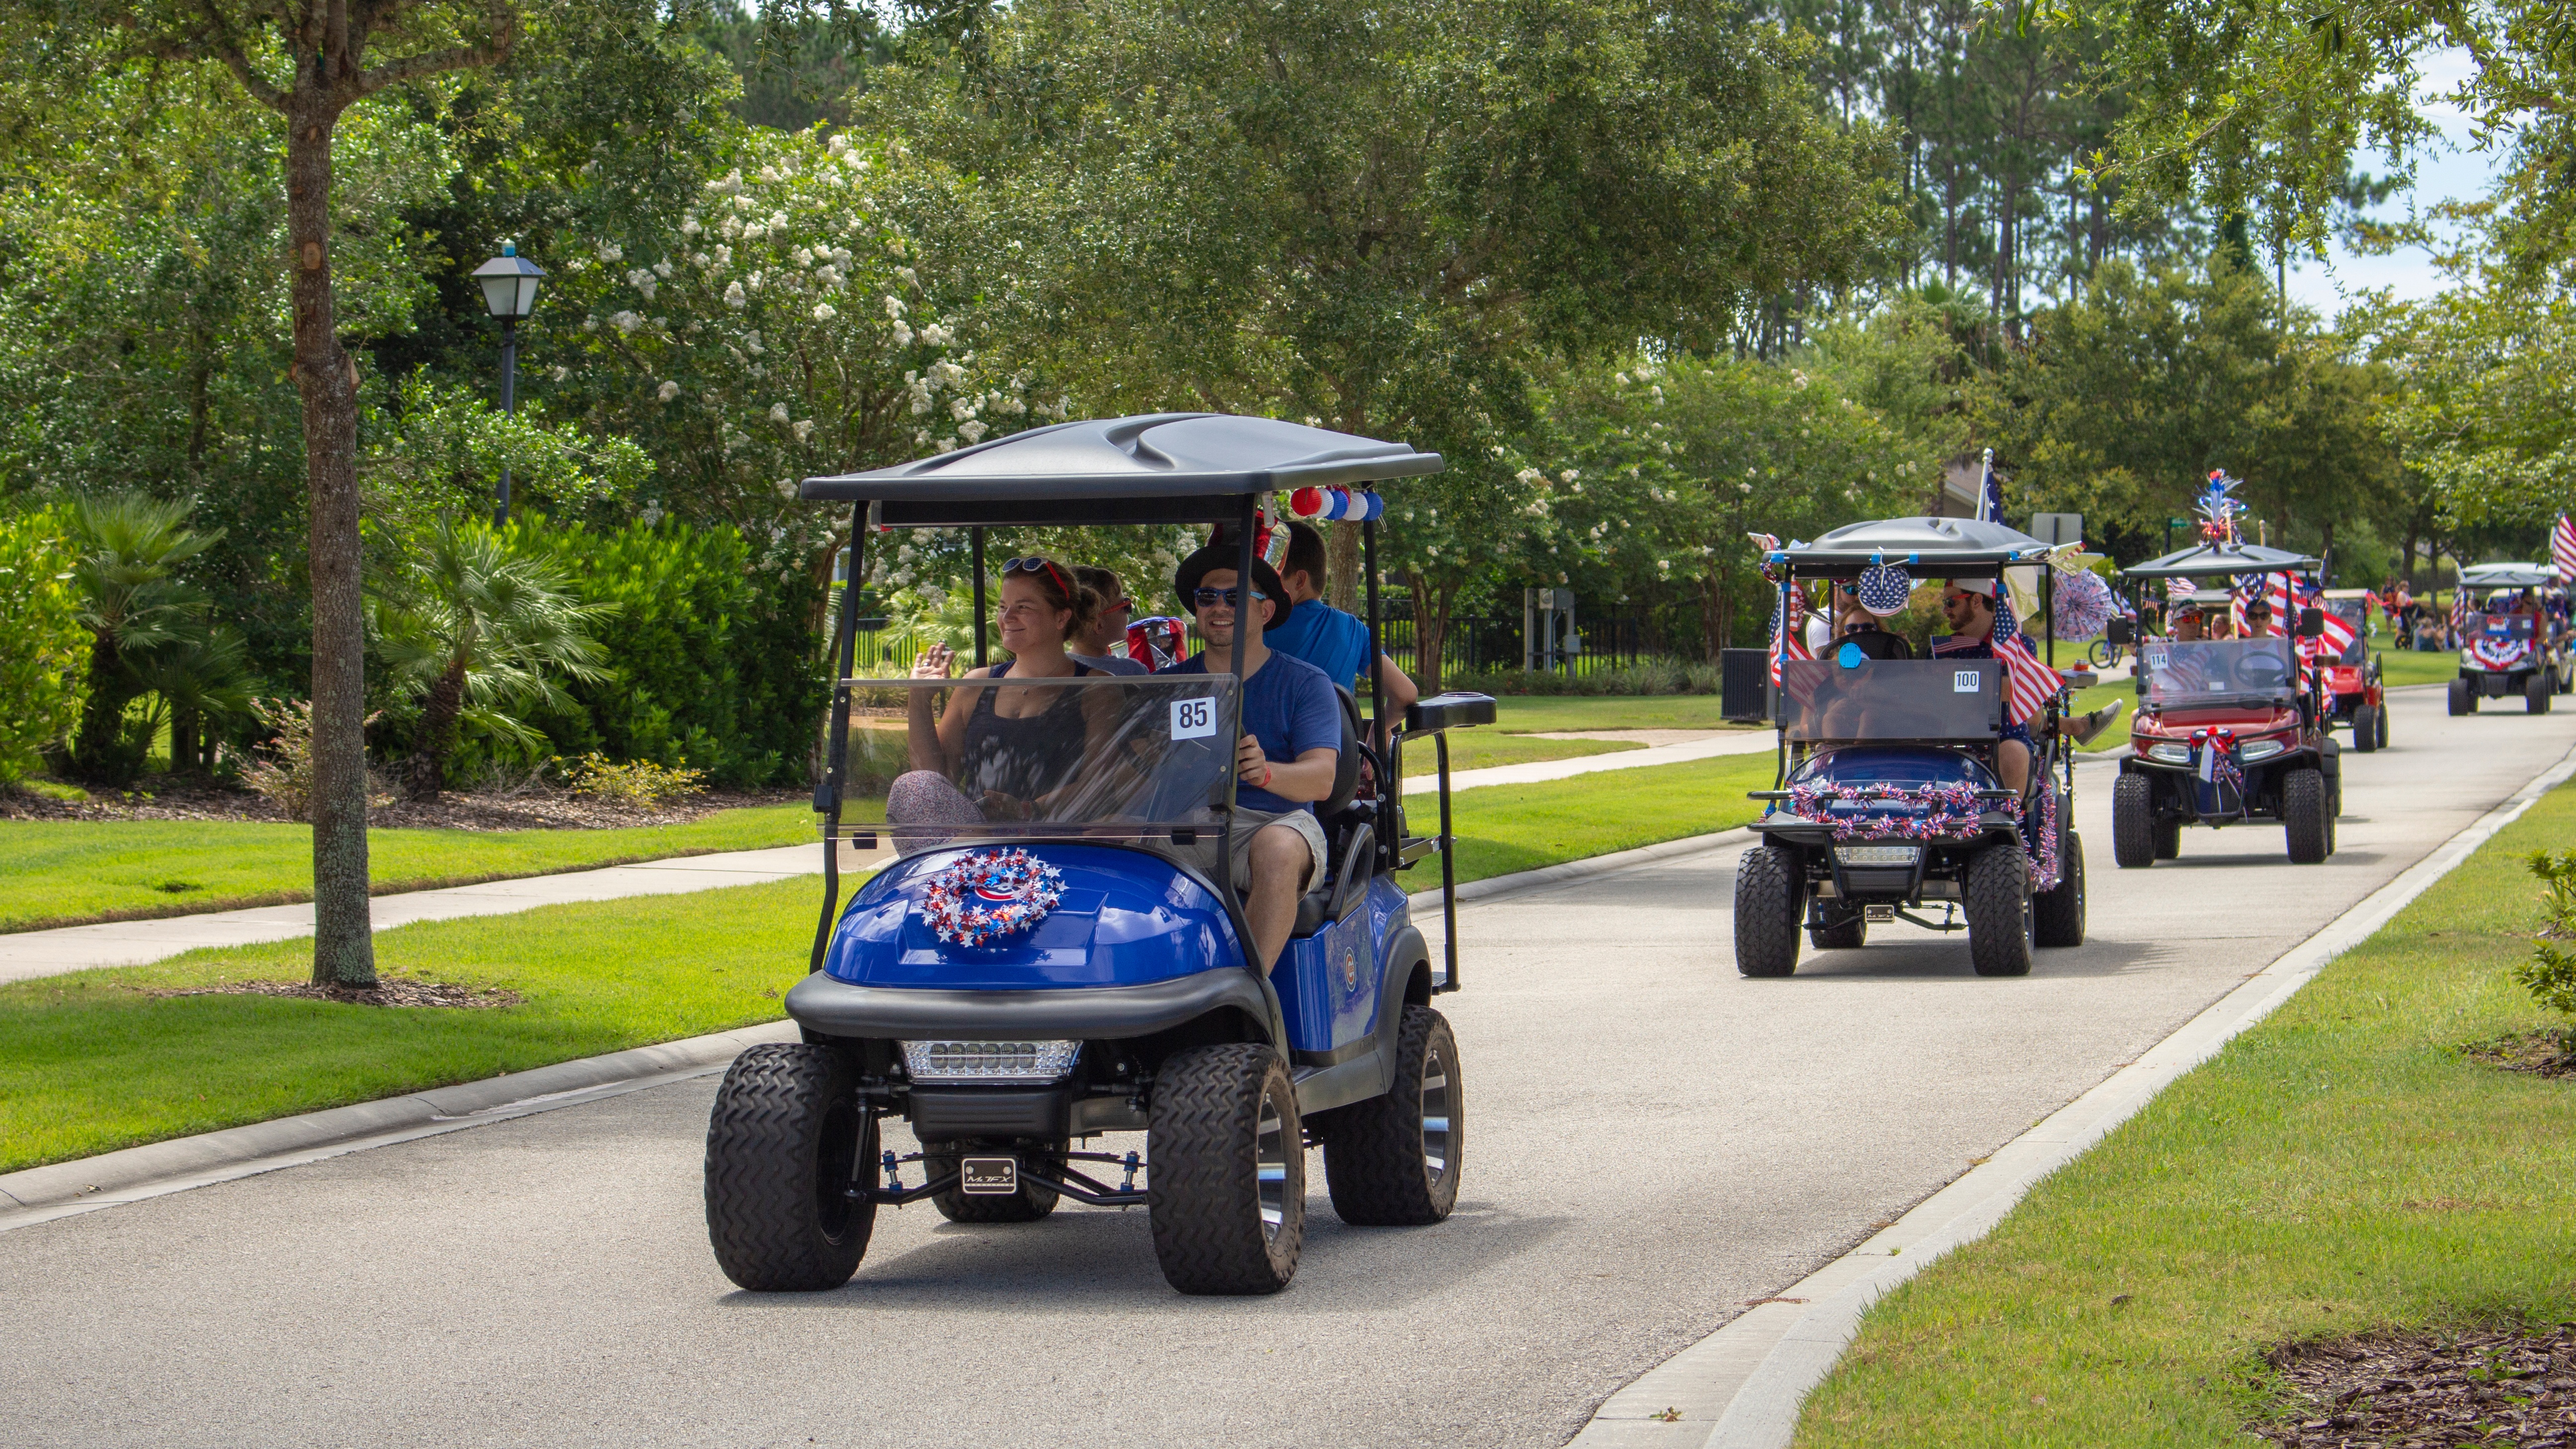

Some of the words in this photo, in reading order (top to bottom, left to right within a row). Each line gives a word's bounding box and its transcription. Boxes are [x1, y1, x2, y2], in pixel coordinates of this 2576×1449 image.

[2152, 655, 2166, 664] 114
[1957, 673, 1977, 686] 100
[1179, 701, 1208, 728] 85
